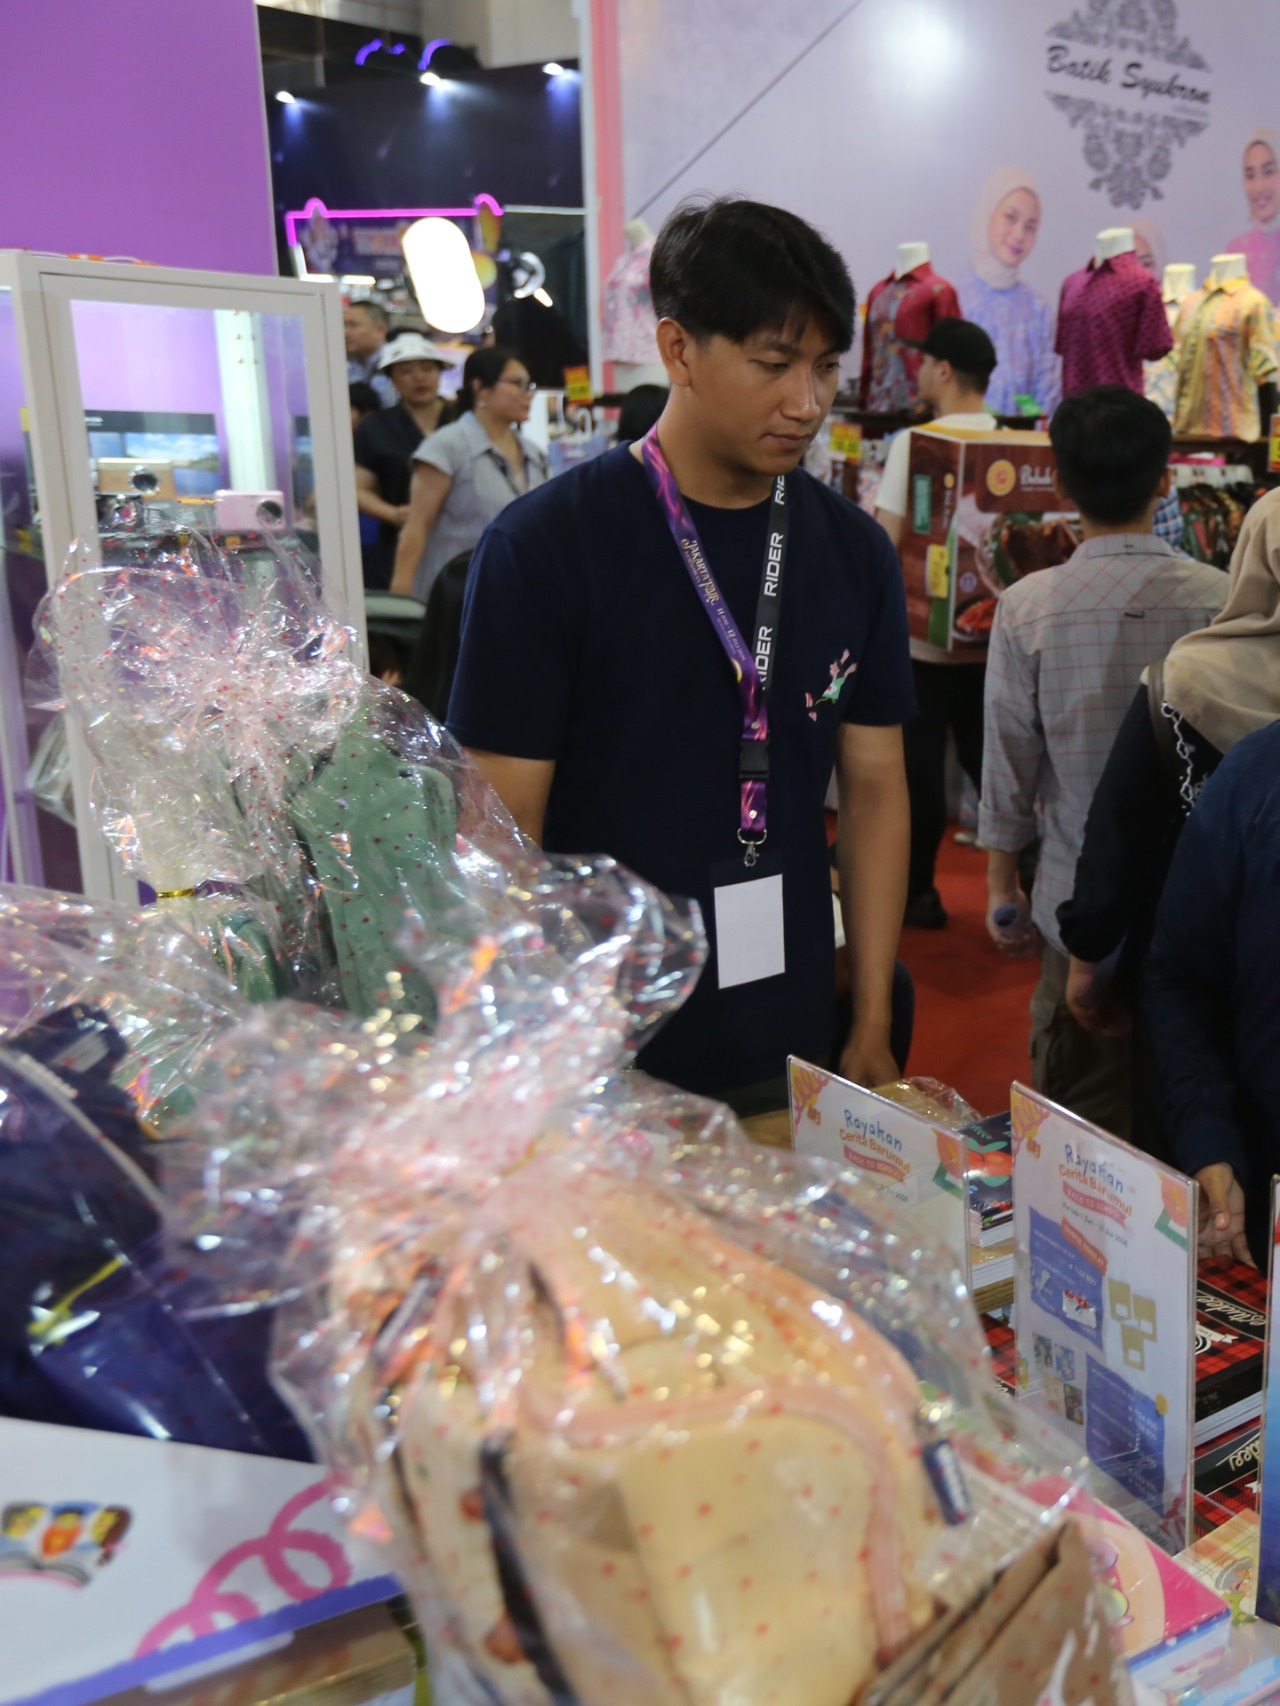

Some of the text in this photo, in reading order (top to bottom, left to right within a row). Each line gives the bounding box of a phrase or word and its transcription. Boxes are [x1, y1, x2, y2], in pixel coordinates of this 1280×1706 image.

[1047, 45, 1211, 104] Batik Syukron
[763, 532, 784, 597] RIDER
[844, 1109, 902, 1151] Rayakan
